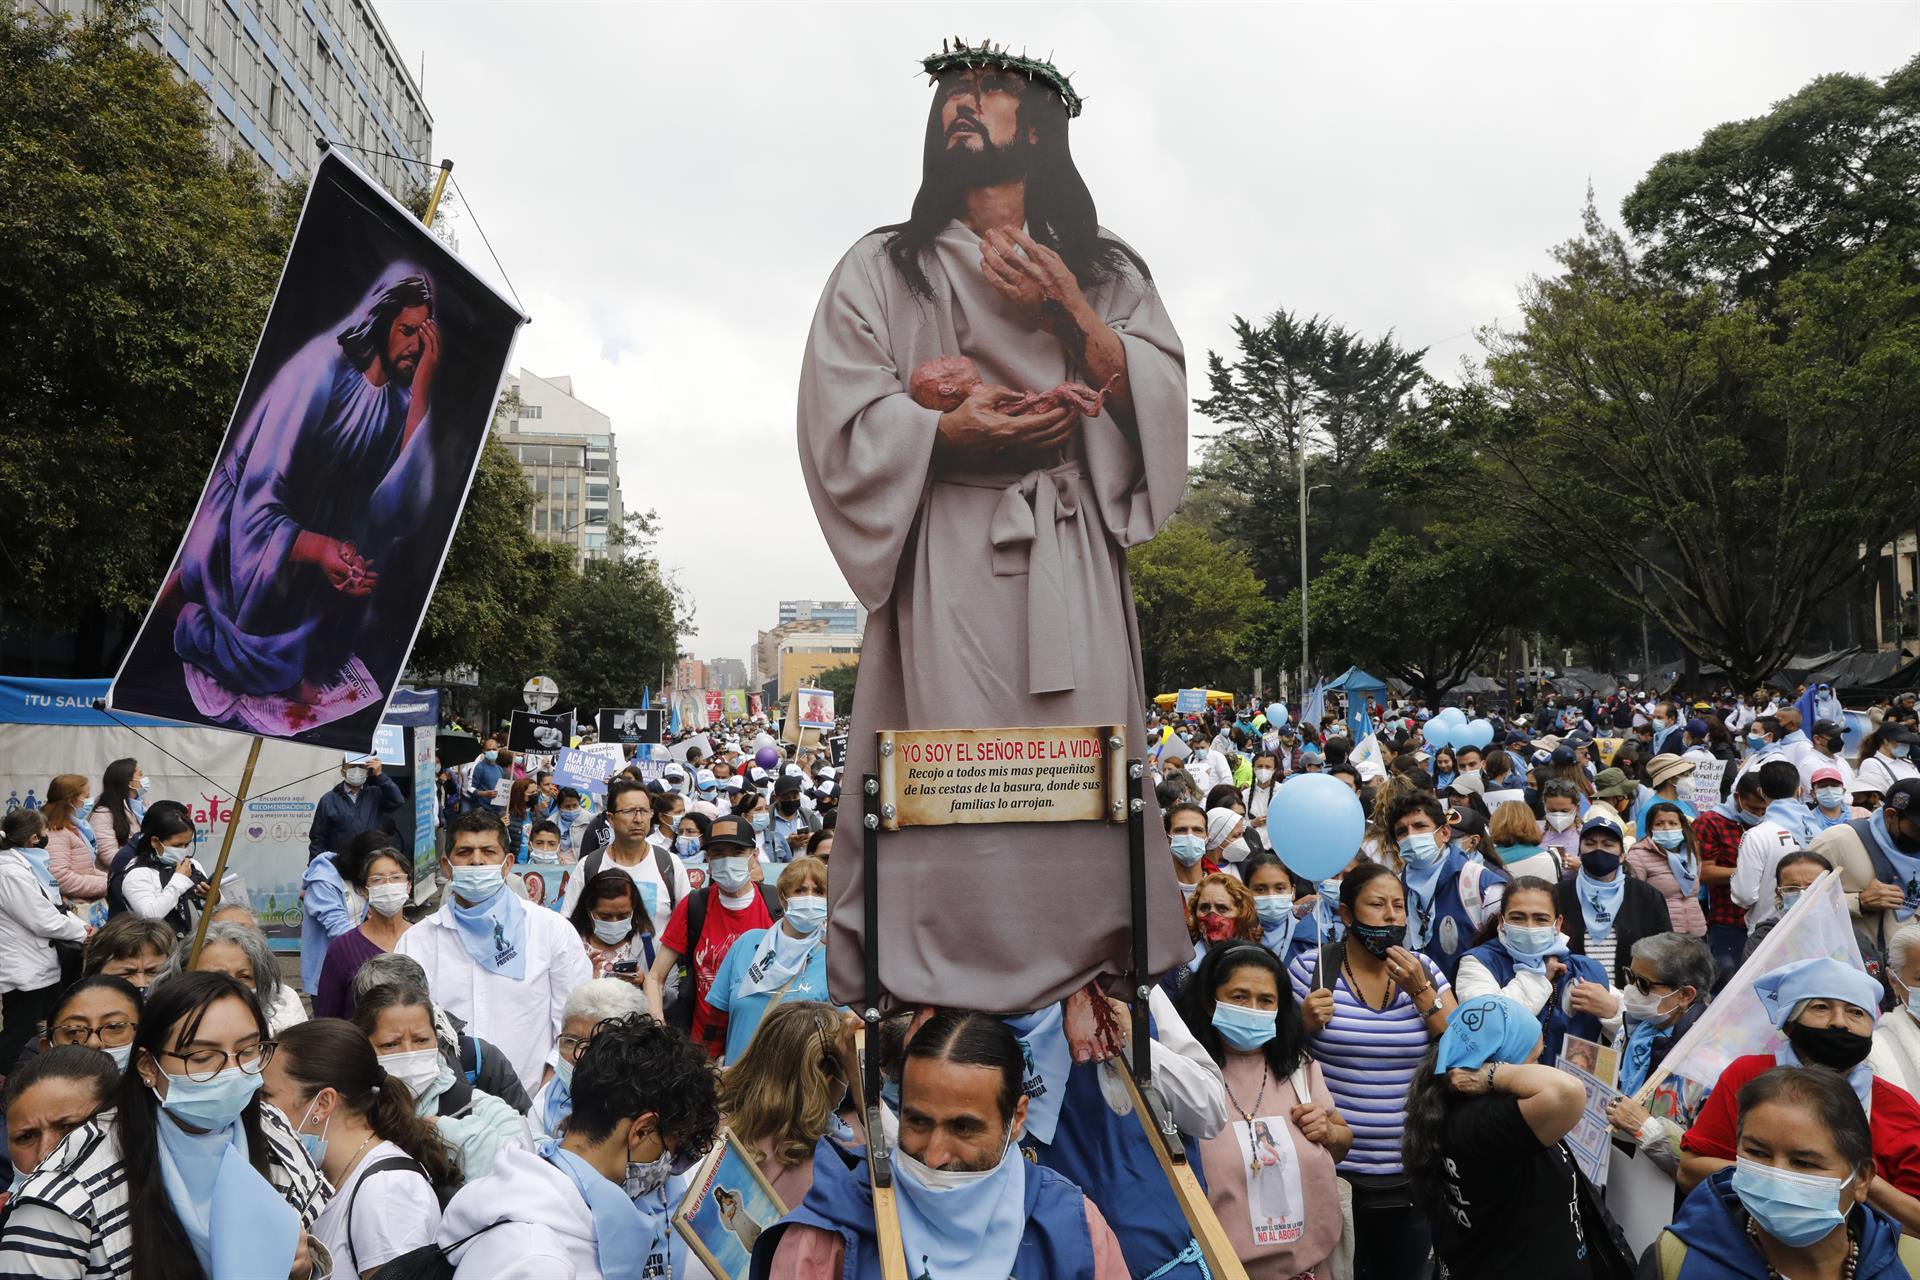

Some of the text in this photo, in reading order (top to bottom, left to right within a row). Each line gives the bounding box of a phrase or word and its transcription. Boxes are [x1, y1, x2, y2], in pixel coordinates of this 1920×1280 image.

[902, 738, 1102, 762] YO SOY EL SEÑOR DE LA VIDA
[908, 768, 944, 781] Recojo
[956, 766, 986, 778] todos
[988, 765, 1009, 777] mis
[1010, 766, 1034, 776] mas
[1035, 763, 1096, 778] pequeñitos
[904, 780, 1101, 796] de las cestas de la basura, donde sus
[949, 797, 1055, 813] familias lo arrojan.
[1258, 1231, 1268, 1242] NO
[1269, 1231, 1278, 1241] AL
